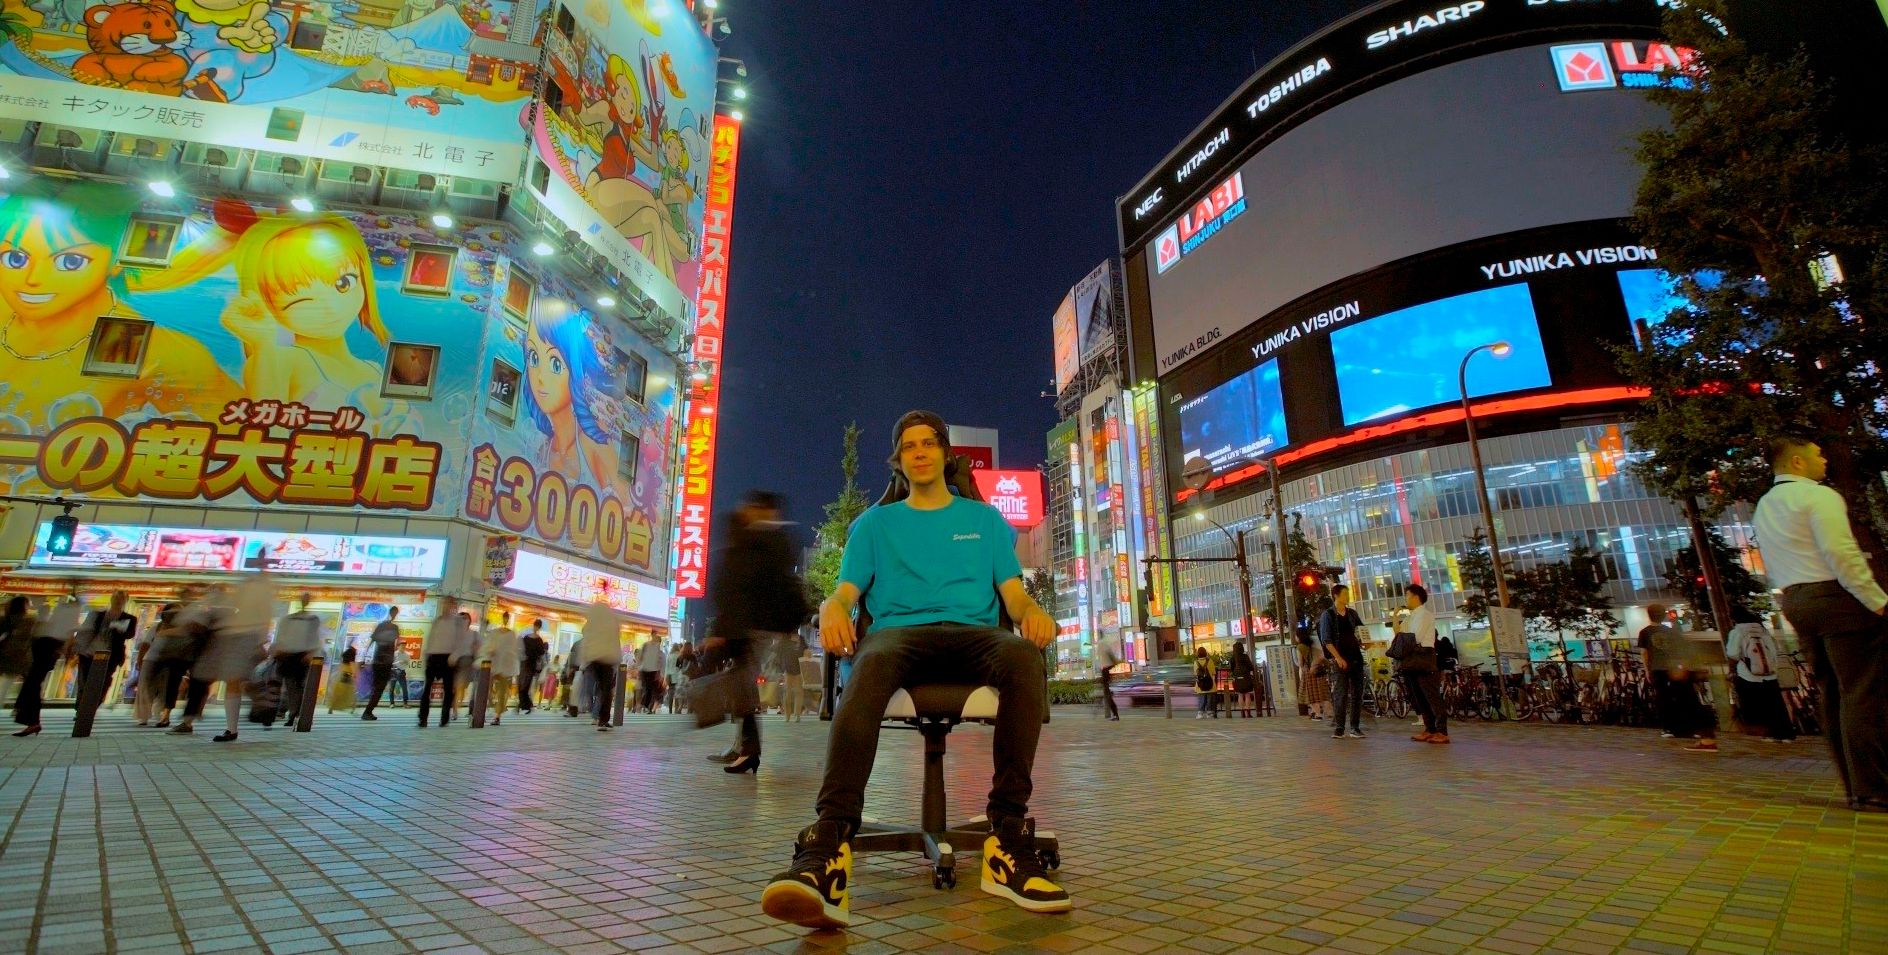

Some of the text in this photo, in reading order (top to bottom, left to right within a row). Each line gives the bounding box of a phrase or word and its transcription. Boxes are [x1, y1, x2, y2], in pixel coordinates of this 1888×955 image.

[1366, 0, 1485, 50] SHARP
[61, 95, 206, 129] キタック販売
[1247, 56, 1332, 119] TOSHIBA
[358, 141, 495, 167] 株式会社 北電子
[711, 126, 736, 204] パチンコ
[1176, 127, 1230, 183] HITACHI
[1134, 186, 1164, 221] NEC
[1178, 170, 1244, 243] LABI
[1182, 217, 1221, 255] SHINJUKU
[1480, 244, 1658, 281] YUNIKA VISION
[699, 208, 727, 329] エスパス
[1161, 326, 1223, 369] YUNIKA BLDG.
[1252, 300, 1361, 360] YUNIKA VISION
[223, 400, 362, 431] メガホール
[686, 416, 712, 495] パチンコ
[469, 446, 498, 518] 合計
[499, 459, 653, 567] 3000台
[990, 496, 1029, 513] GAME
[679, 504, 705, 591] エスパス
